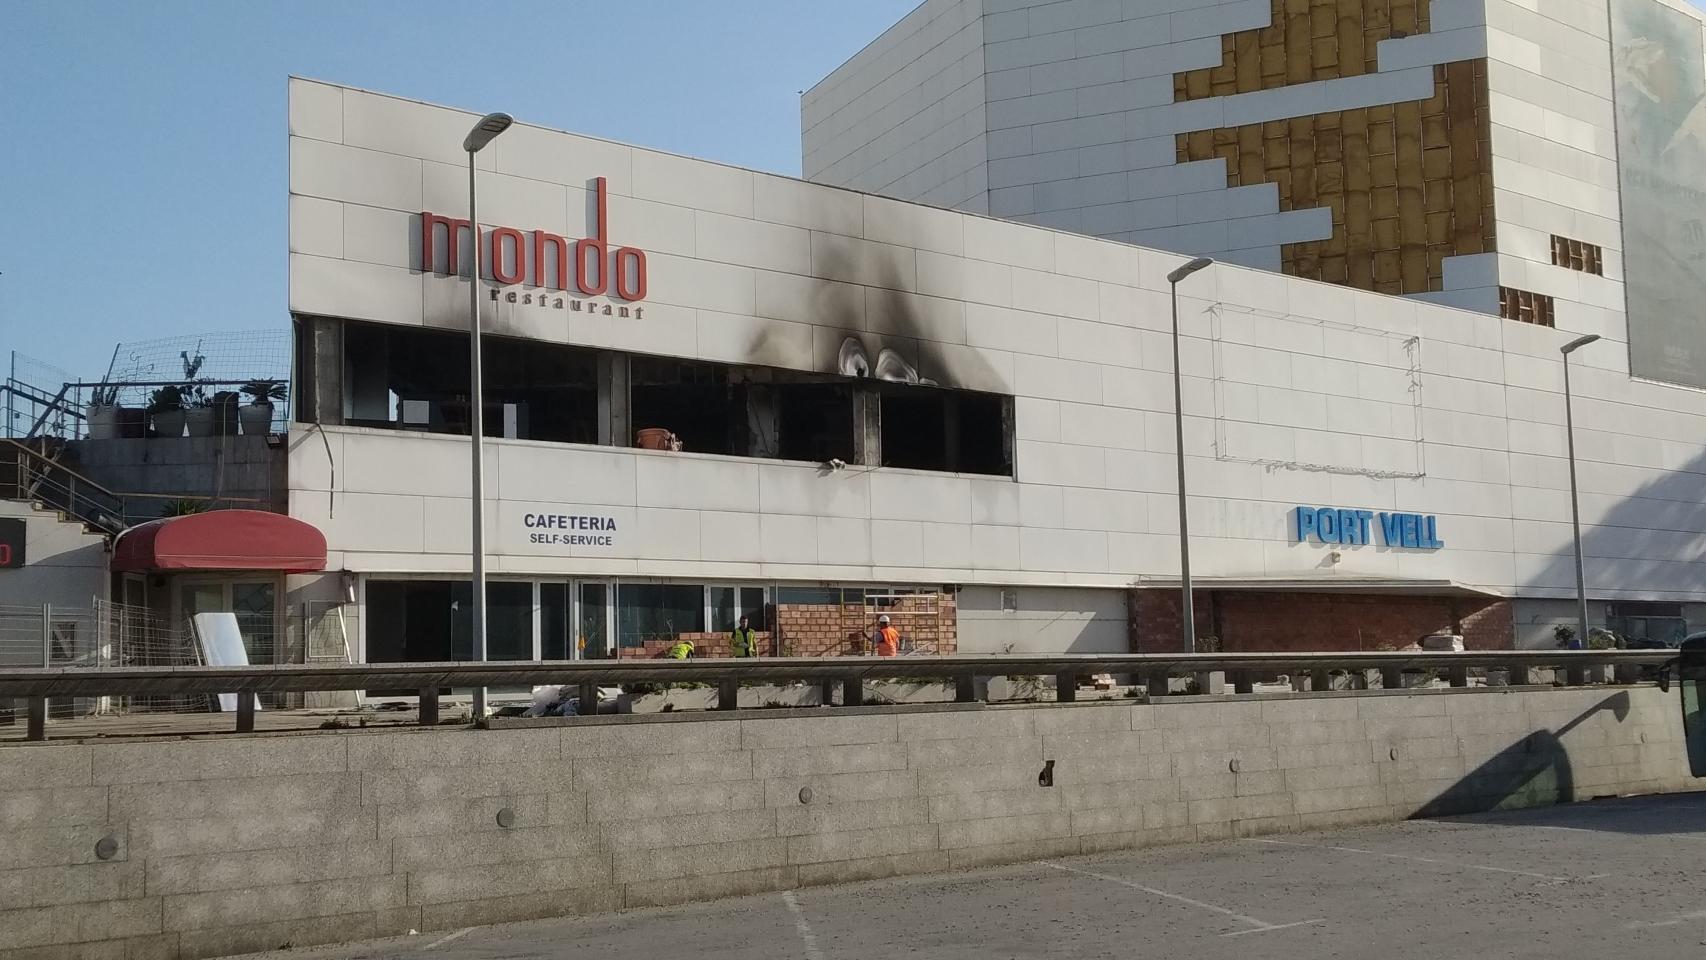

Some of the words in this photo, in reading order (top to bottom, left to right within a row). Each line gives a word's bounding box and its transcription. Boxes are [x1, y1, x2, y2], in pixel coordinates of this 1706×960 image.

[421, 176, 647, 302] mondo
[489, 287, 644, 320] restaurant
[524, 513, 617, 531] CAFETERIA
[1297, 506, 1373, 545] PORT
[1379, 512, 1445, 550] VELL
[530, 533, 613, 546] SELF-SERVICE
